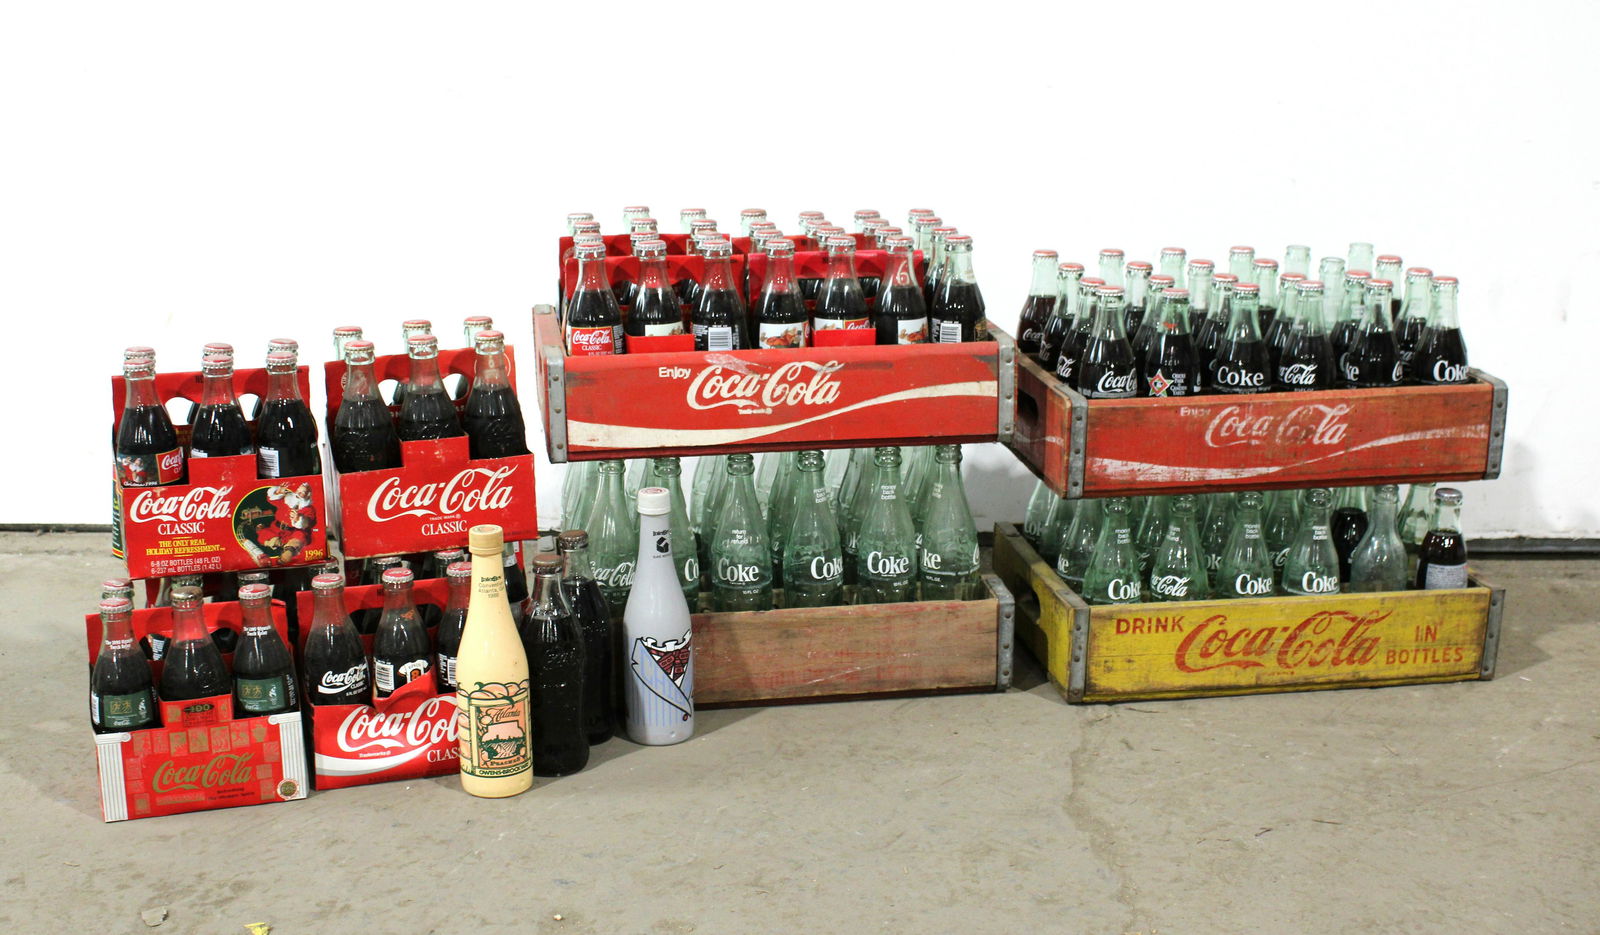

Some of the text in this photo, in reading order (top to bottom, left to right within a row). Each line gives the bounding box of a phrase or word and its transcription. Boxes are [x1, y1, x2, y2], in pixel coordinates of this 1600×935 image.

[572, 329, 612, 345] Coca-Cola
[658, 360, 845, 410] Enjoy Coca-Cola
[1217, 366, 1265, 387] Coke
[367, 464, 518, 522] Coca-Cola
[130, 486, 233, 523] Coca-Cola
[157, 522, 205, 536] CLASSIC
[421, 520, 468, 536] CLASSIC
[146, 548, 173, 556] HOLIDAY
[159, 540, 173, 548] THE
[304, 549, 324, 558] 1996
[169, 558, 193, 566] BOTTLES
[177, 564, 201, 572] BOTTLES
[684, 558, 699, 582] Co
[718, 557, 759, 582] Coke
[867, 551, 909, 575] Coke
[924, 548, 941, 570] ke
[1235, 573, 1272, 595] Coke
[1302, 571, 1338, 593] Coke
[1116, 610, 1394, 674] DRINK Coca-Cola
[1414, 624, 1438, 642] IN
[1385, 646, 1464, 665] BOTTLES
[322, 663, 368, 687] Coca-Cola
[337, 696, 459, 752] Coca-Col
[427, 747, 461, 763] CLAS
[152, 753, 254, 793] Coca-Cola
